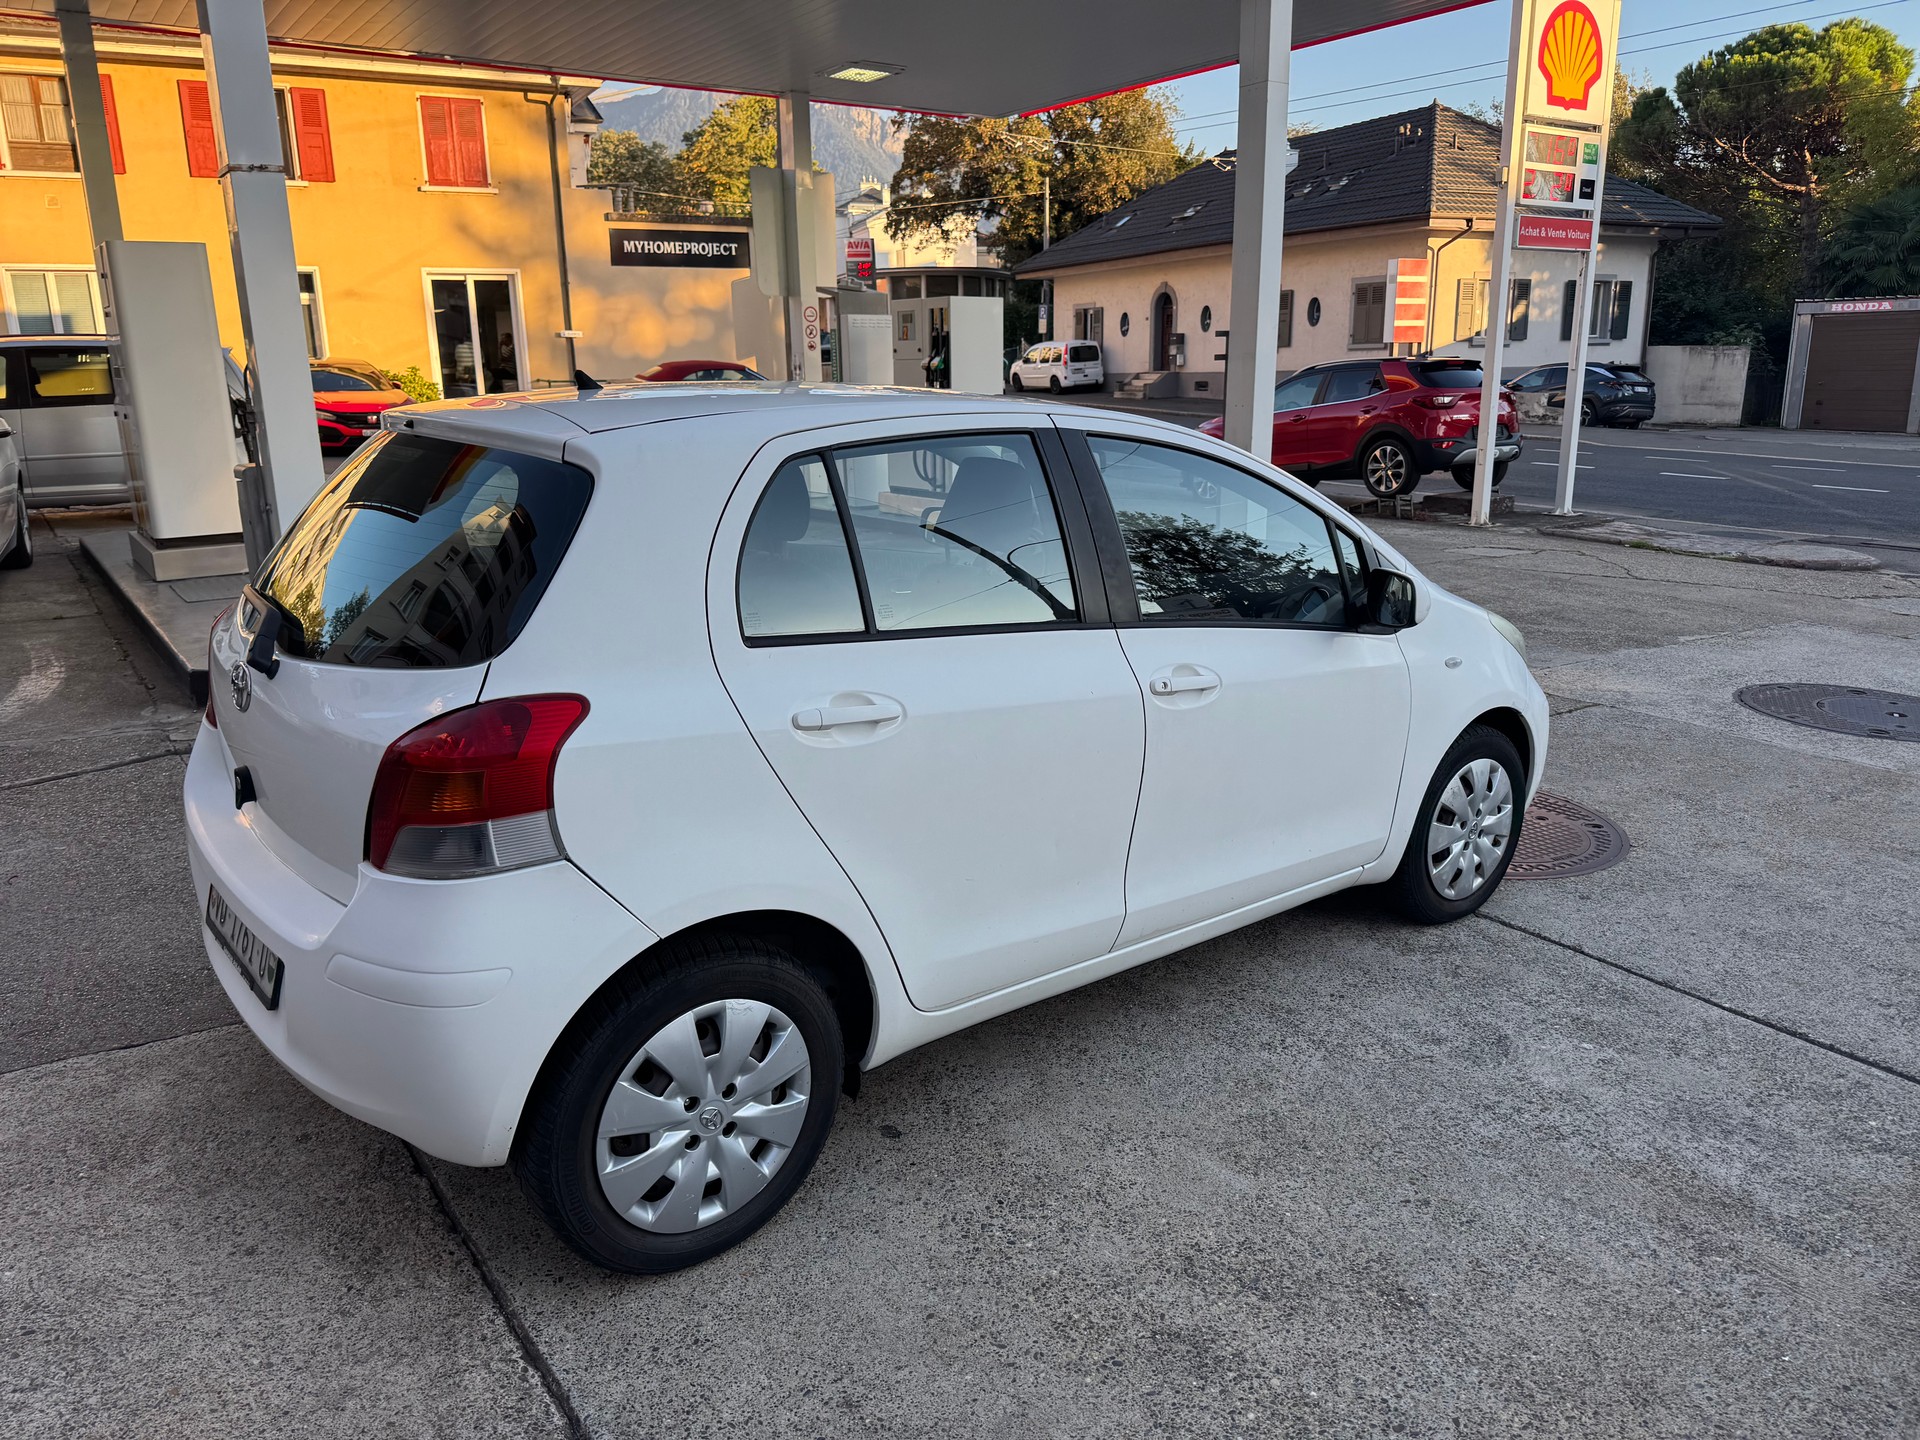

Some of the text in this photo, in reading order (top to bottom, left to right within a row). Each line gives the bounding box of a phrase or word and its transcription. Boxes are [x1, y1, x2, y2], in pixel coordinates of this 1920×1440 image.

[1520, 226, 1590, 240] Achat & Vente Voiture
[623, 240, 738, 257] MYHOMEPROJECT
[847, 239, 870, 249] AVIA
[1831, 301, 1892, 311] HONDA
